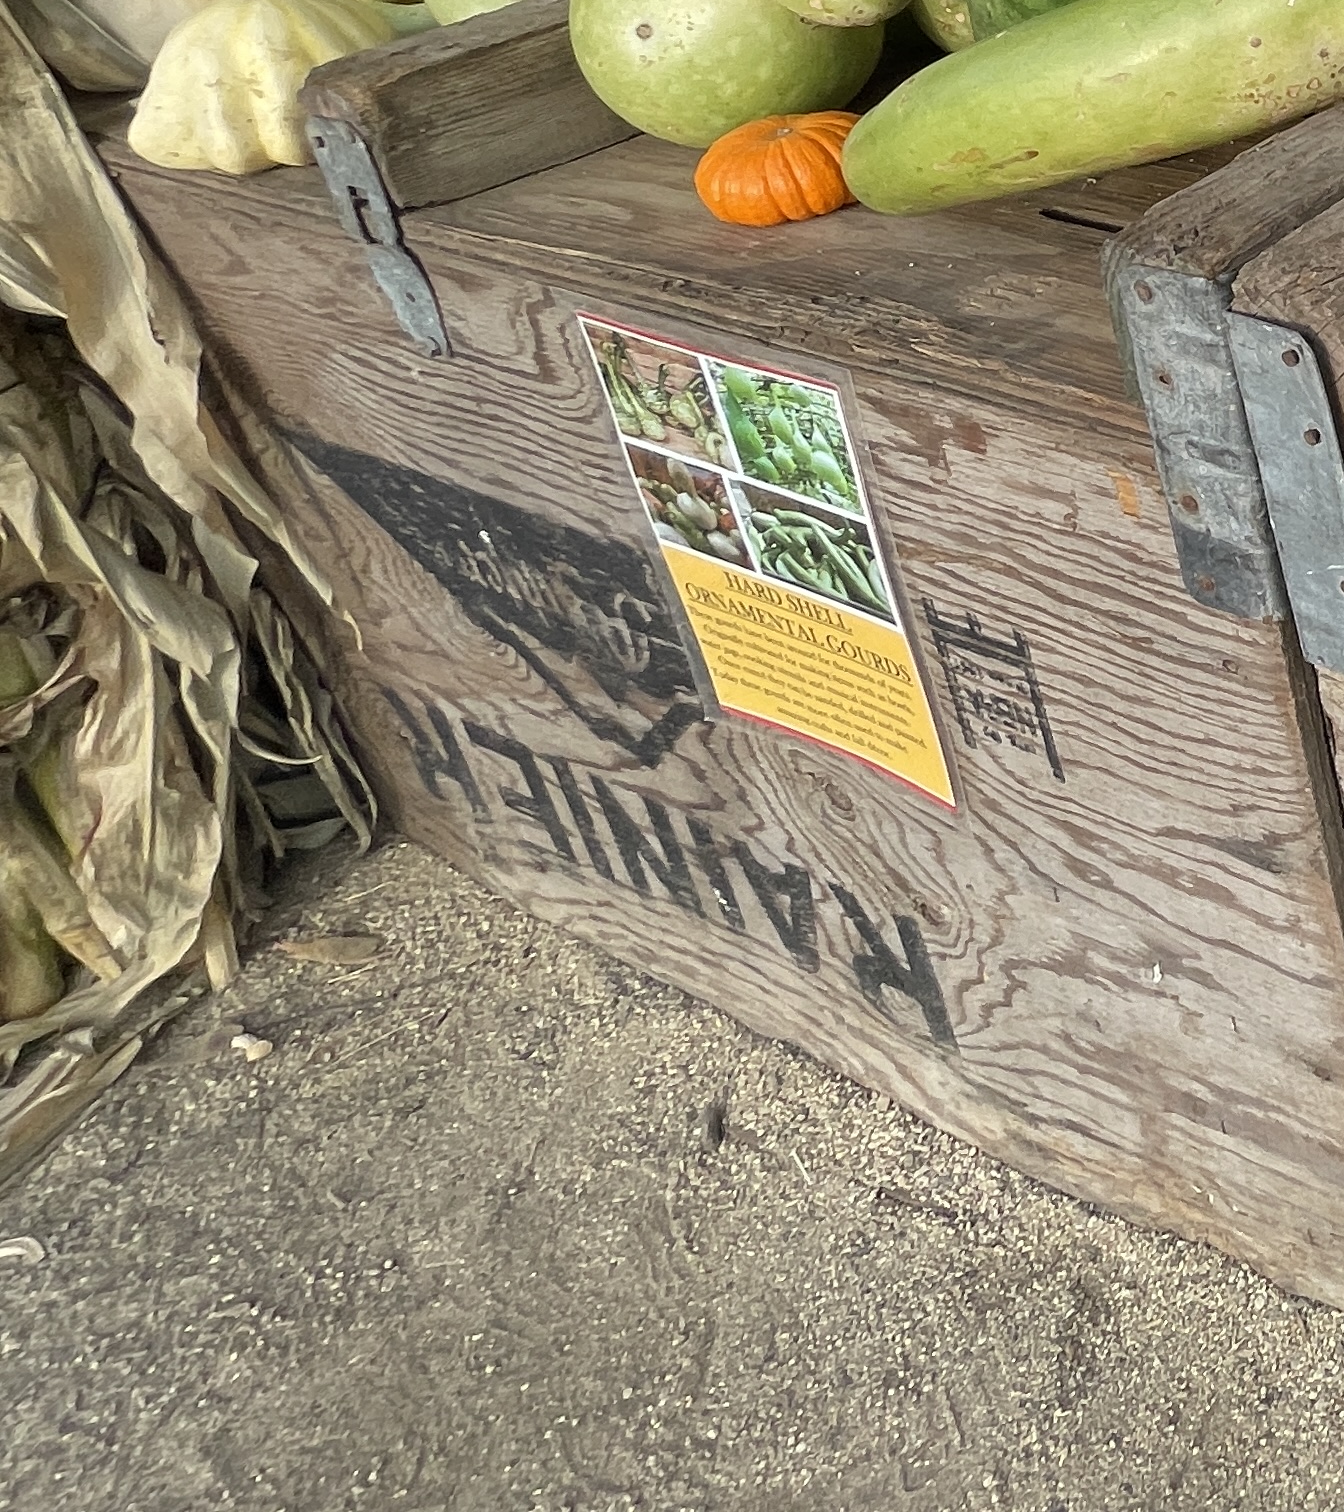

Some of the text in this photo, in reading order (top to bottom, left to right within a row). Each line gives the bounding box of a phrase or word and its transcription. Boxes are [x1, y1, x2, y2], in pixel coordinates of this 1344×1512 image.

[685, 581, 911, 683] ORNAMENTAL GOURDS
[724, 571, 852, 631] HARD SHELL
